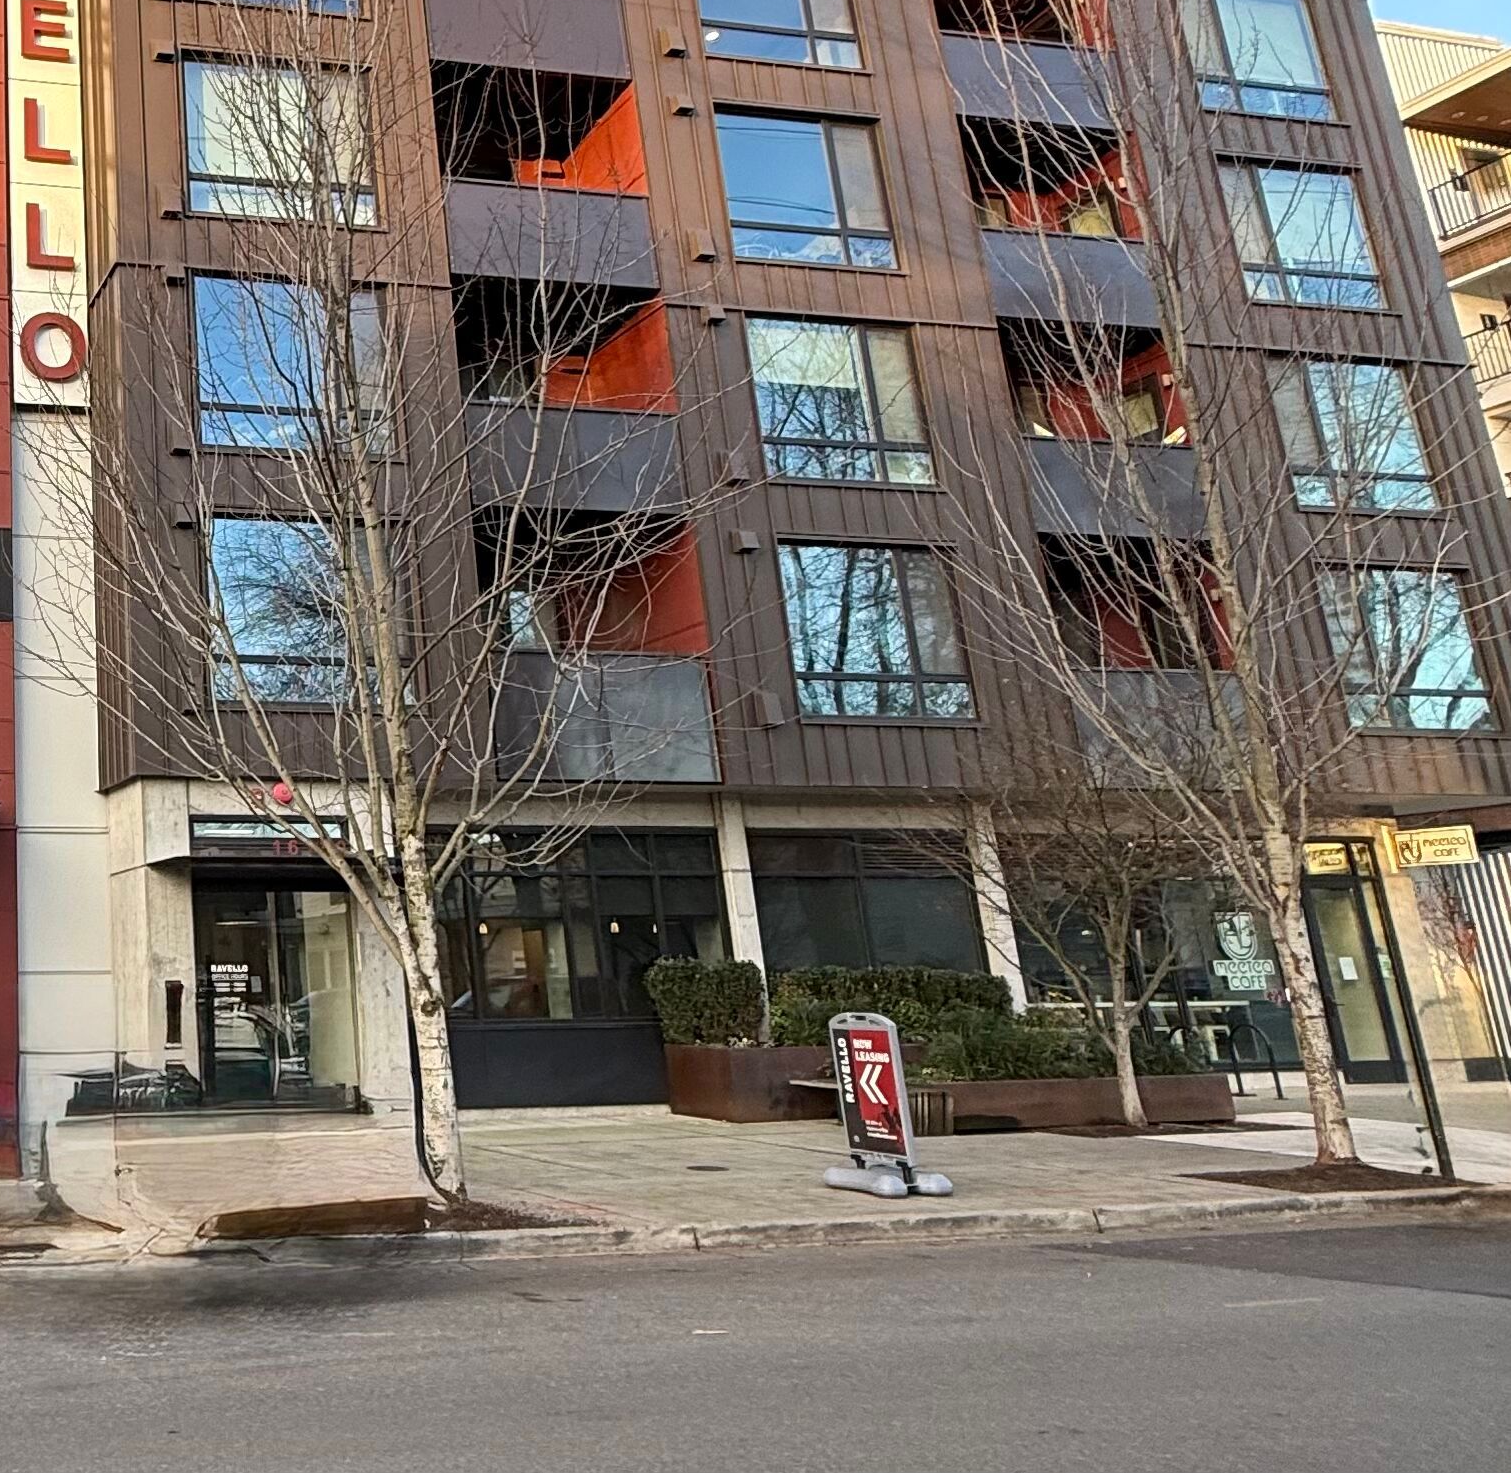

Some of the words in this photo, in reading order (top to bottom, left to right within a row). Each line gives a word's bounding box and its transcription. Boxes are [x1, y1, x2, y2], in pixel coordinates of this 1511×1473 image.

[210, 964, 249, 973] RAVELLO
[1230, 975, 1265, 989] CAFE
[852, 1039, 873, 1050] NOW
[854, 1050, 890, 1064] LEASING
[837, 1038, 856, 1104] RAVELLO
